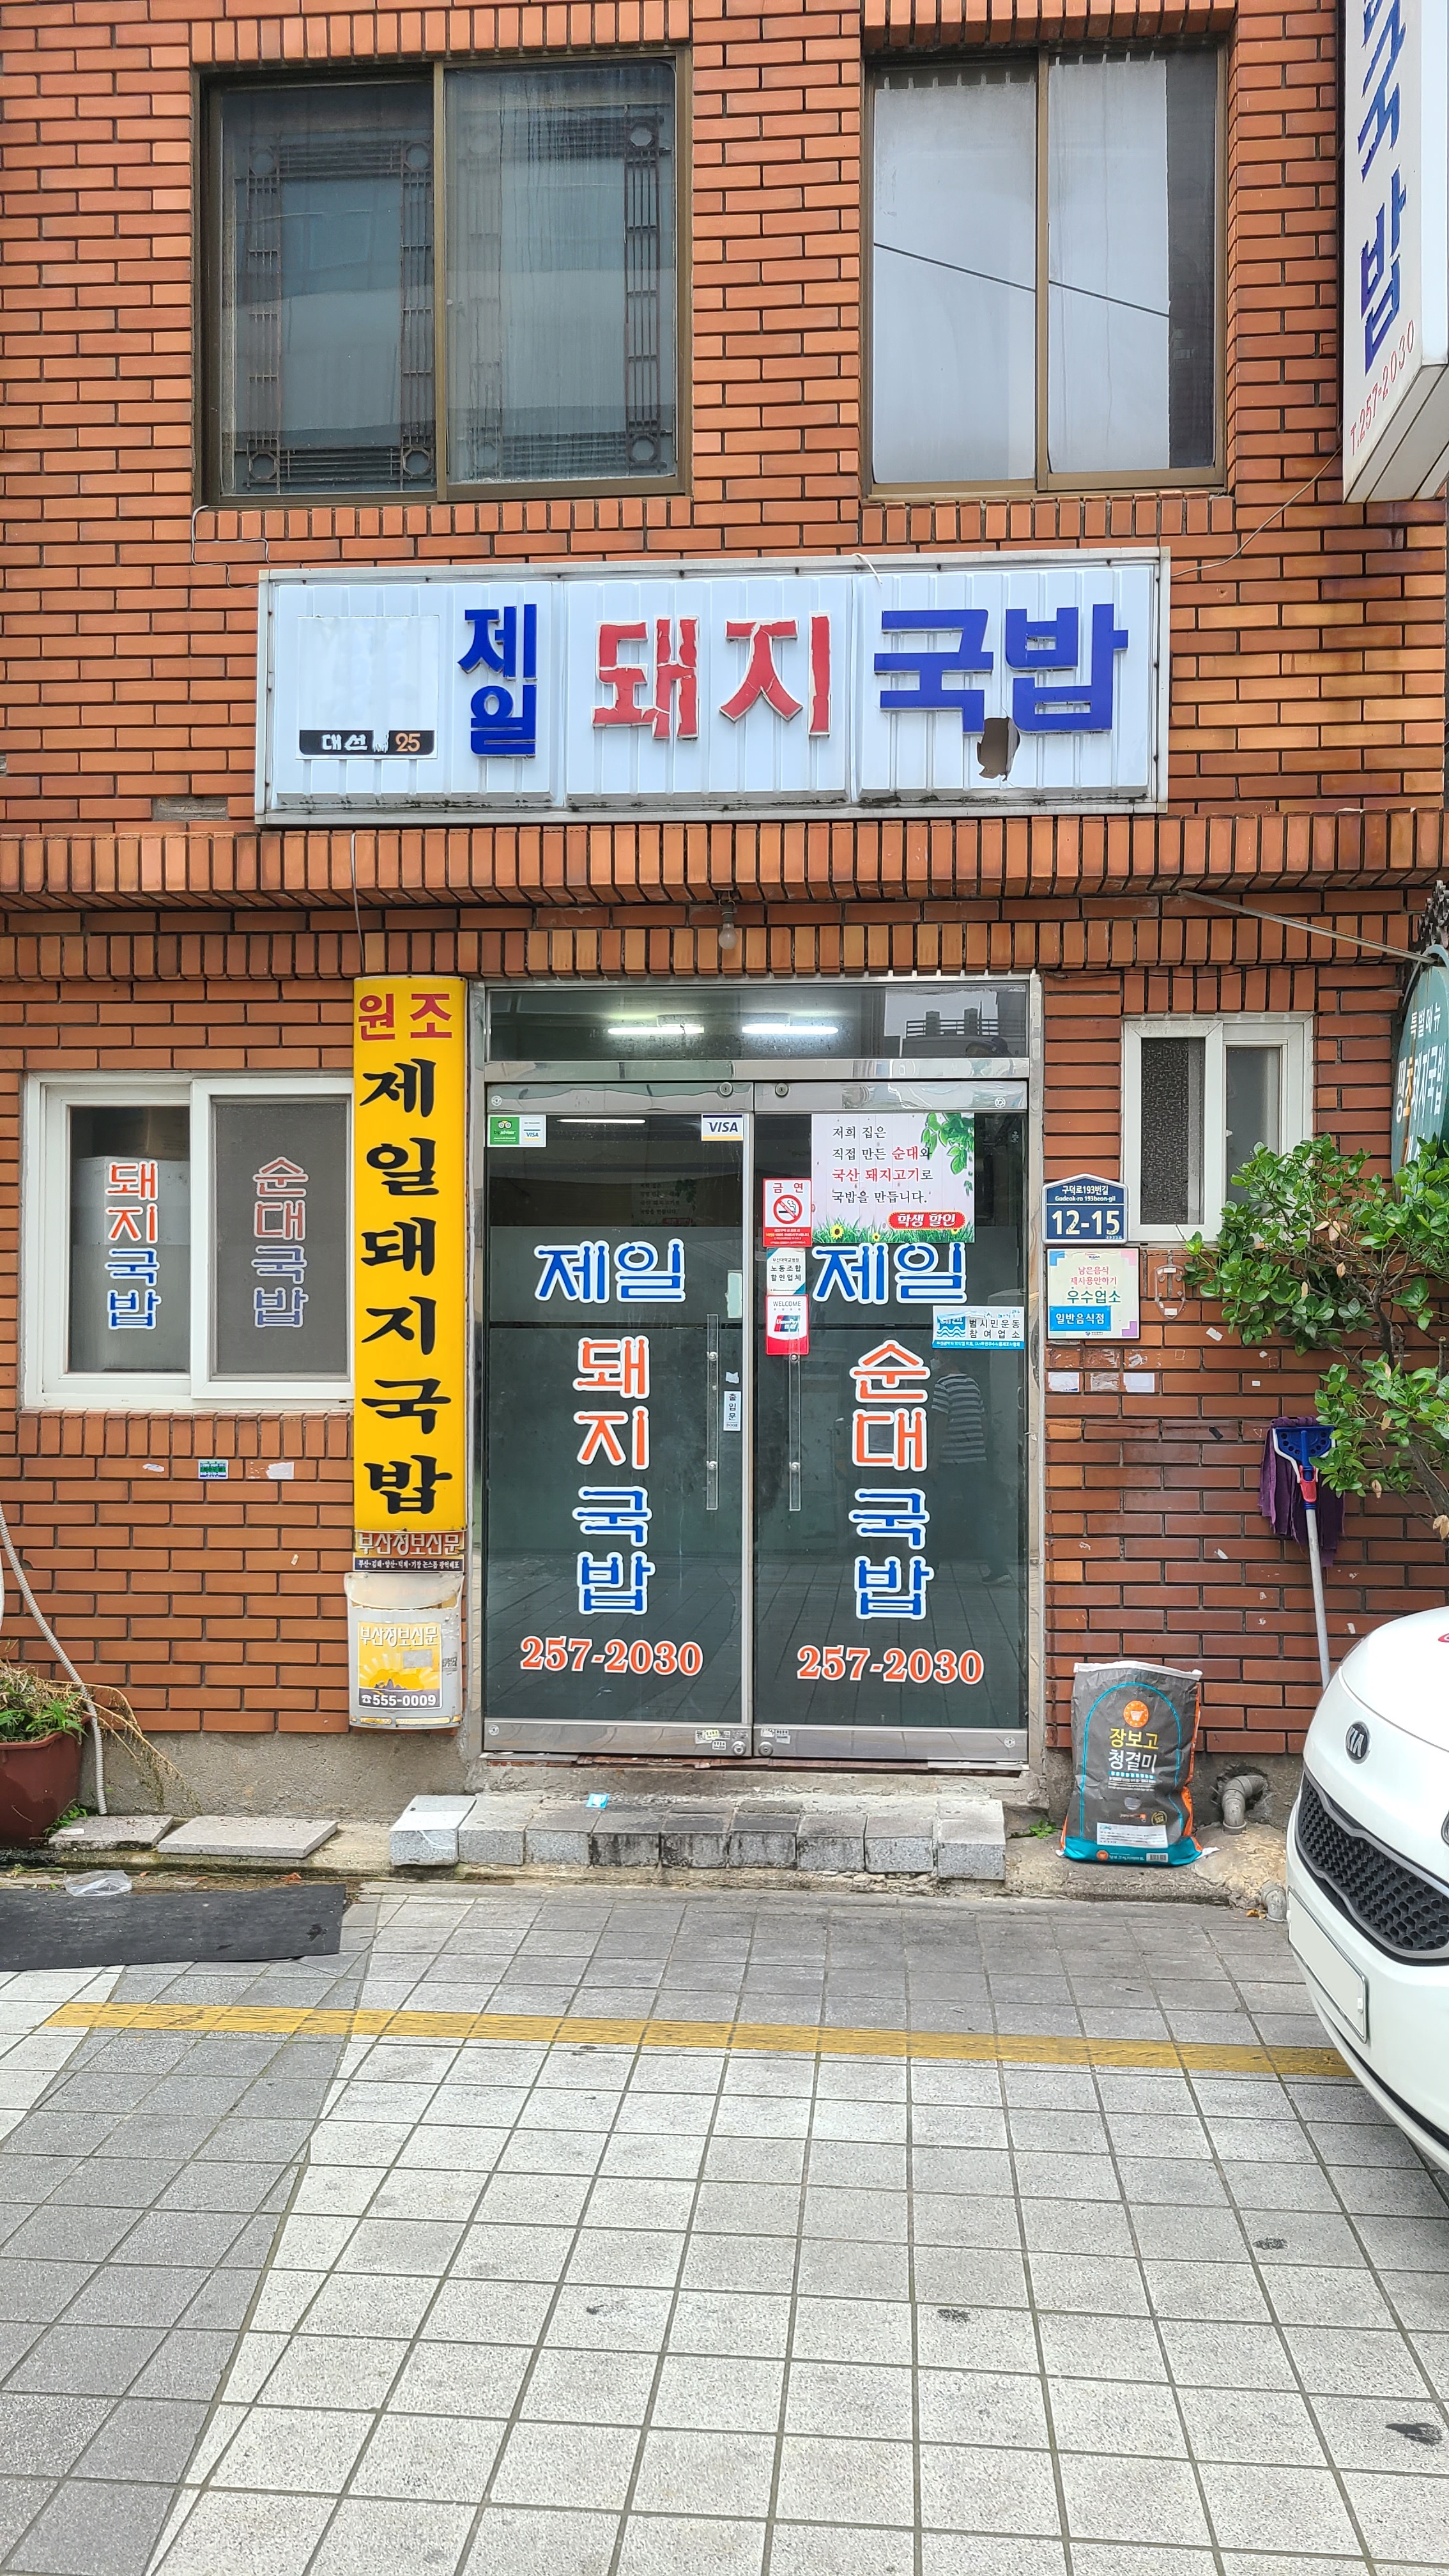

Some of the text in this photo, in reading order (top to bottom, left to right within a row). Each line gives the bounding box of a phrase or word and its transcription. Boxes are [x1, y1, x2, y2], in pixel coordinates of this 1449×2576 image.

[457, 603, 537, 758] 제일
[395, 733, 422, 753] 25
[358, 993, 453, 1041] 원조
[707, 1121, 739, 1133] VISA
[832, 1126, 887, 1139] 저희 집은
[832, 1146, 933, 1161] 직접 만든 순대와
[831, 1167, 933, 1183] 국산 돼지고기로
[831, 1190, 928, 1204] 국밥을 만듭니다.
[1061, 1184, 1109, 1195] 구덕로193번길
[897, 1213, 957, 1227] 학생 할인
[1052, 1209, 1120, 1236] 12-15
[534, 1238, 686, 1305] 제일
[770, 1264, 801, 1273] 노동조합
[811, 1242, 968, 1305] 제일
[1066, 1290, 1121, 1304] 우수업소
[1055, 1312, 1105, 1324] 일반음식점
[358, 1533, 461, 1556] 부산정보신문
[360, 1625, 438, 1648] 부산정보신문
[519, 1634, 704, 1677] 257-2030
[797, 1644, 985, 1685] 257-2030
[372, 1694, 436, 1706] 555-0009
[1108, 1728, 1159, 1750] 장보고
[1346, 1726, 1365, 1758] KIA
[1108, 1749, 1158, 1773] 청결미
